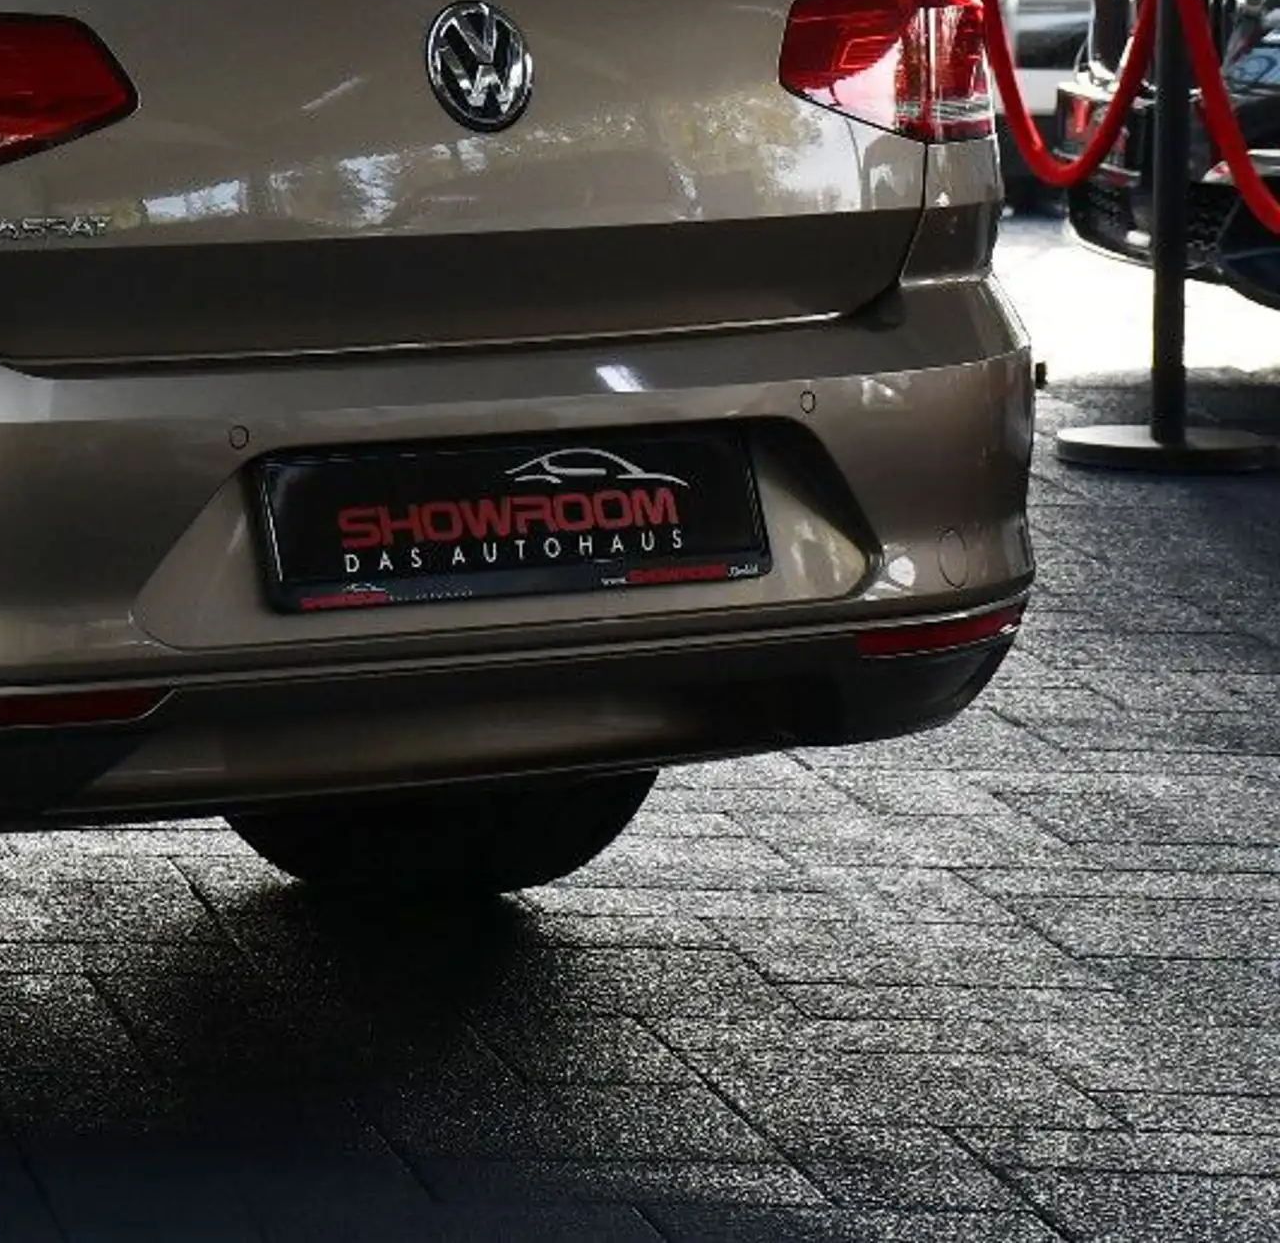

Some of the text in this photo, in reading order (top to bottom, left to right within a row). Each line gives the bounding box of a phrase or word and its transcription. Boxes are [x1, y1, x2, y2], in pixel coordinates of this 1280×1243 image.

[337, 487, 680, 550] SHOWROOM
[344, 528, 685, 574] DAS AUTOHAUS
